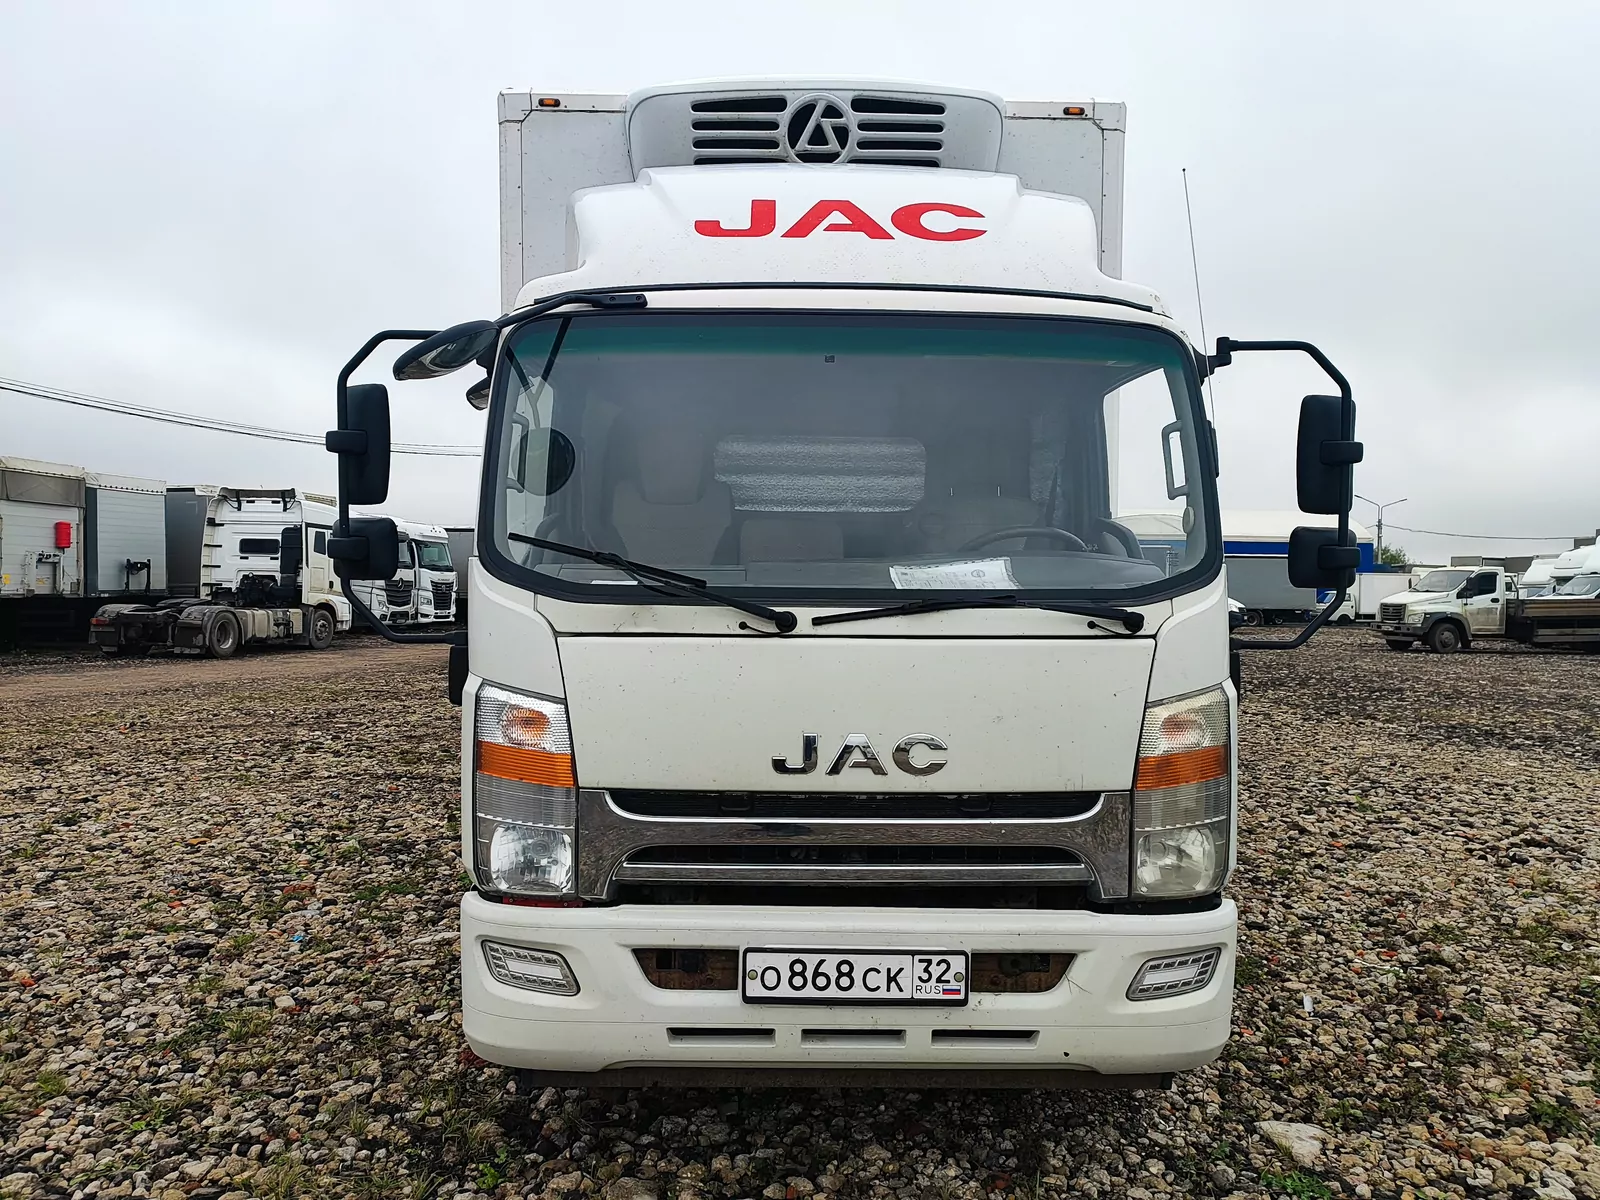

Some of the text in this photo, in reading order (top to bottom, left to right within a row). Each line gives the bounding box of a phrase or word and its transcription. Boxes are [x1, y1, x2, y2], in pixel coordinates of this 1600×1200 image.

[694, 199, 988, 241] JAC
[771, 733, 948, 776] JAC
[917, 958, 951, 984] 32
[915, 984, 941, 995] RUS
